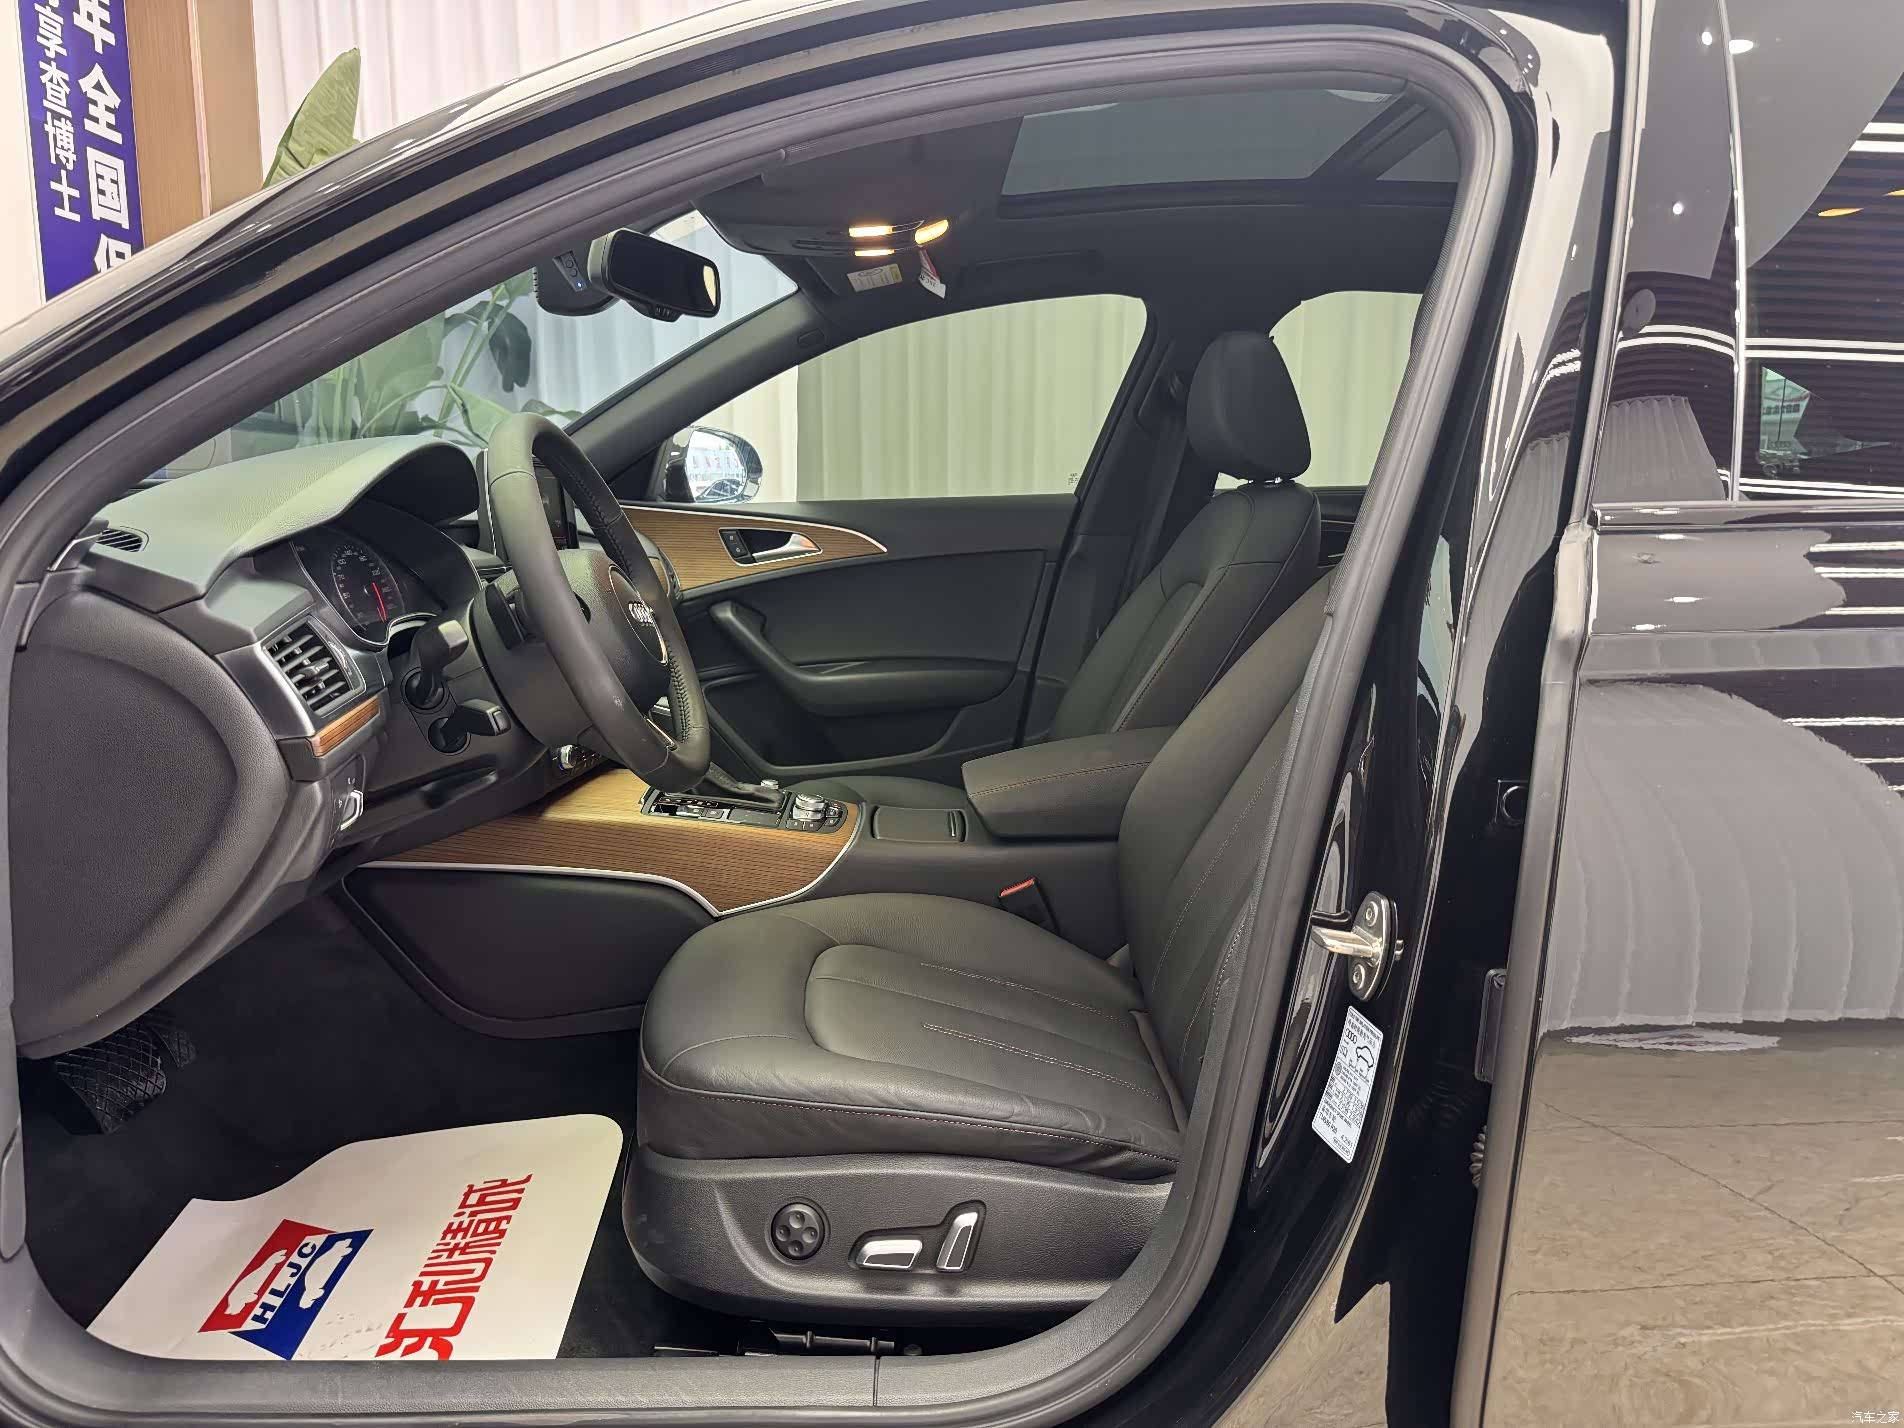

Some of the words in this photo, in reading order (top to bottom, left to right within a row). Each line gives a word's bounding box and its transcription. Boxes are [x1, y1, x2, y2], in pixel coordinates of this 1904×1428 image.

[34, 0, 81, 223] 享查博士
[251, 1242, 317, 1325] HLJC
[375, 1174, 533, 1360] 汇利精诚
